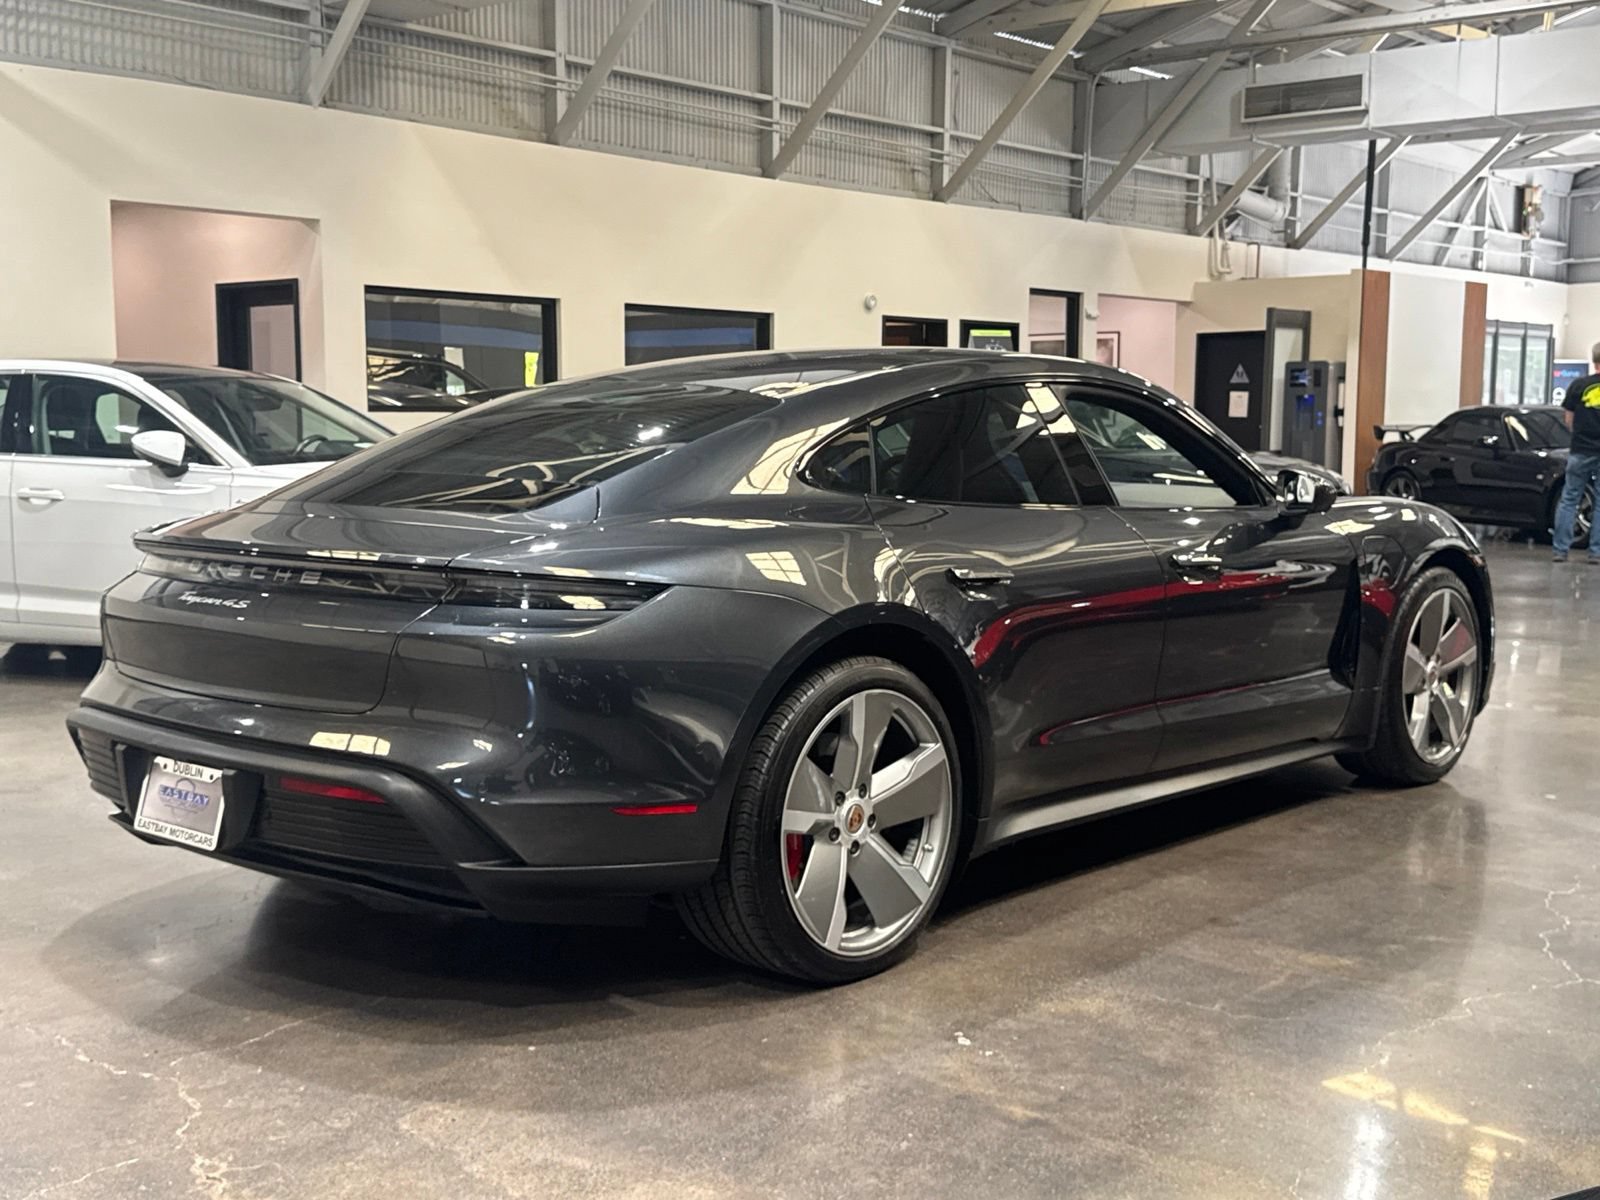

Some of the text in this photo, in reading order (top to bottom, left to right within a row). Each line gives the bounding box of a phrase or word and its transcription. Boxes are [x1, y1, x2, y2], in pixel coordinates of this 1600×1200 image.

[173, 760, 204, 779] DUBLIN
[160, 784, 209, 807] EASTBAY
[137, 818, 214, 848] EASTBAY MOTORCARS
